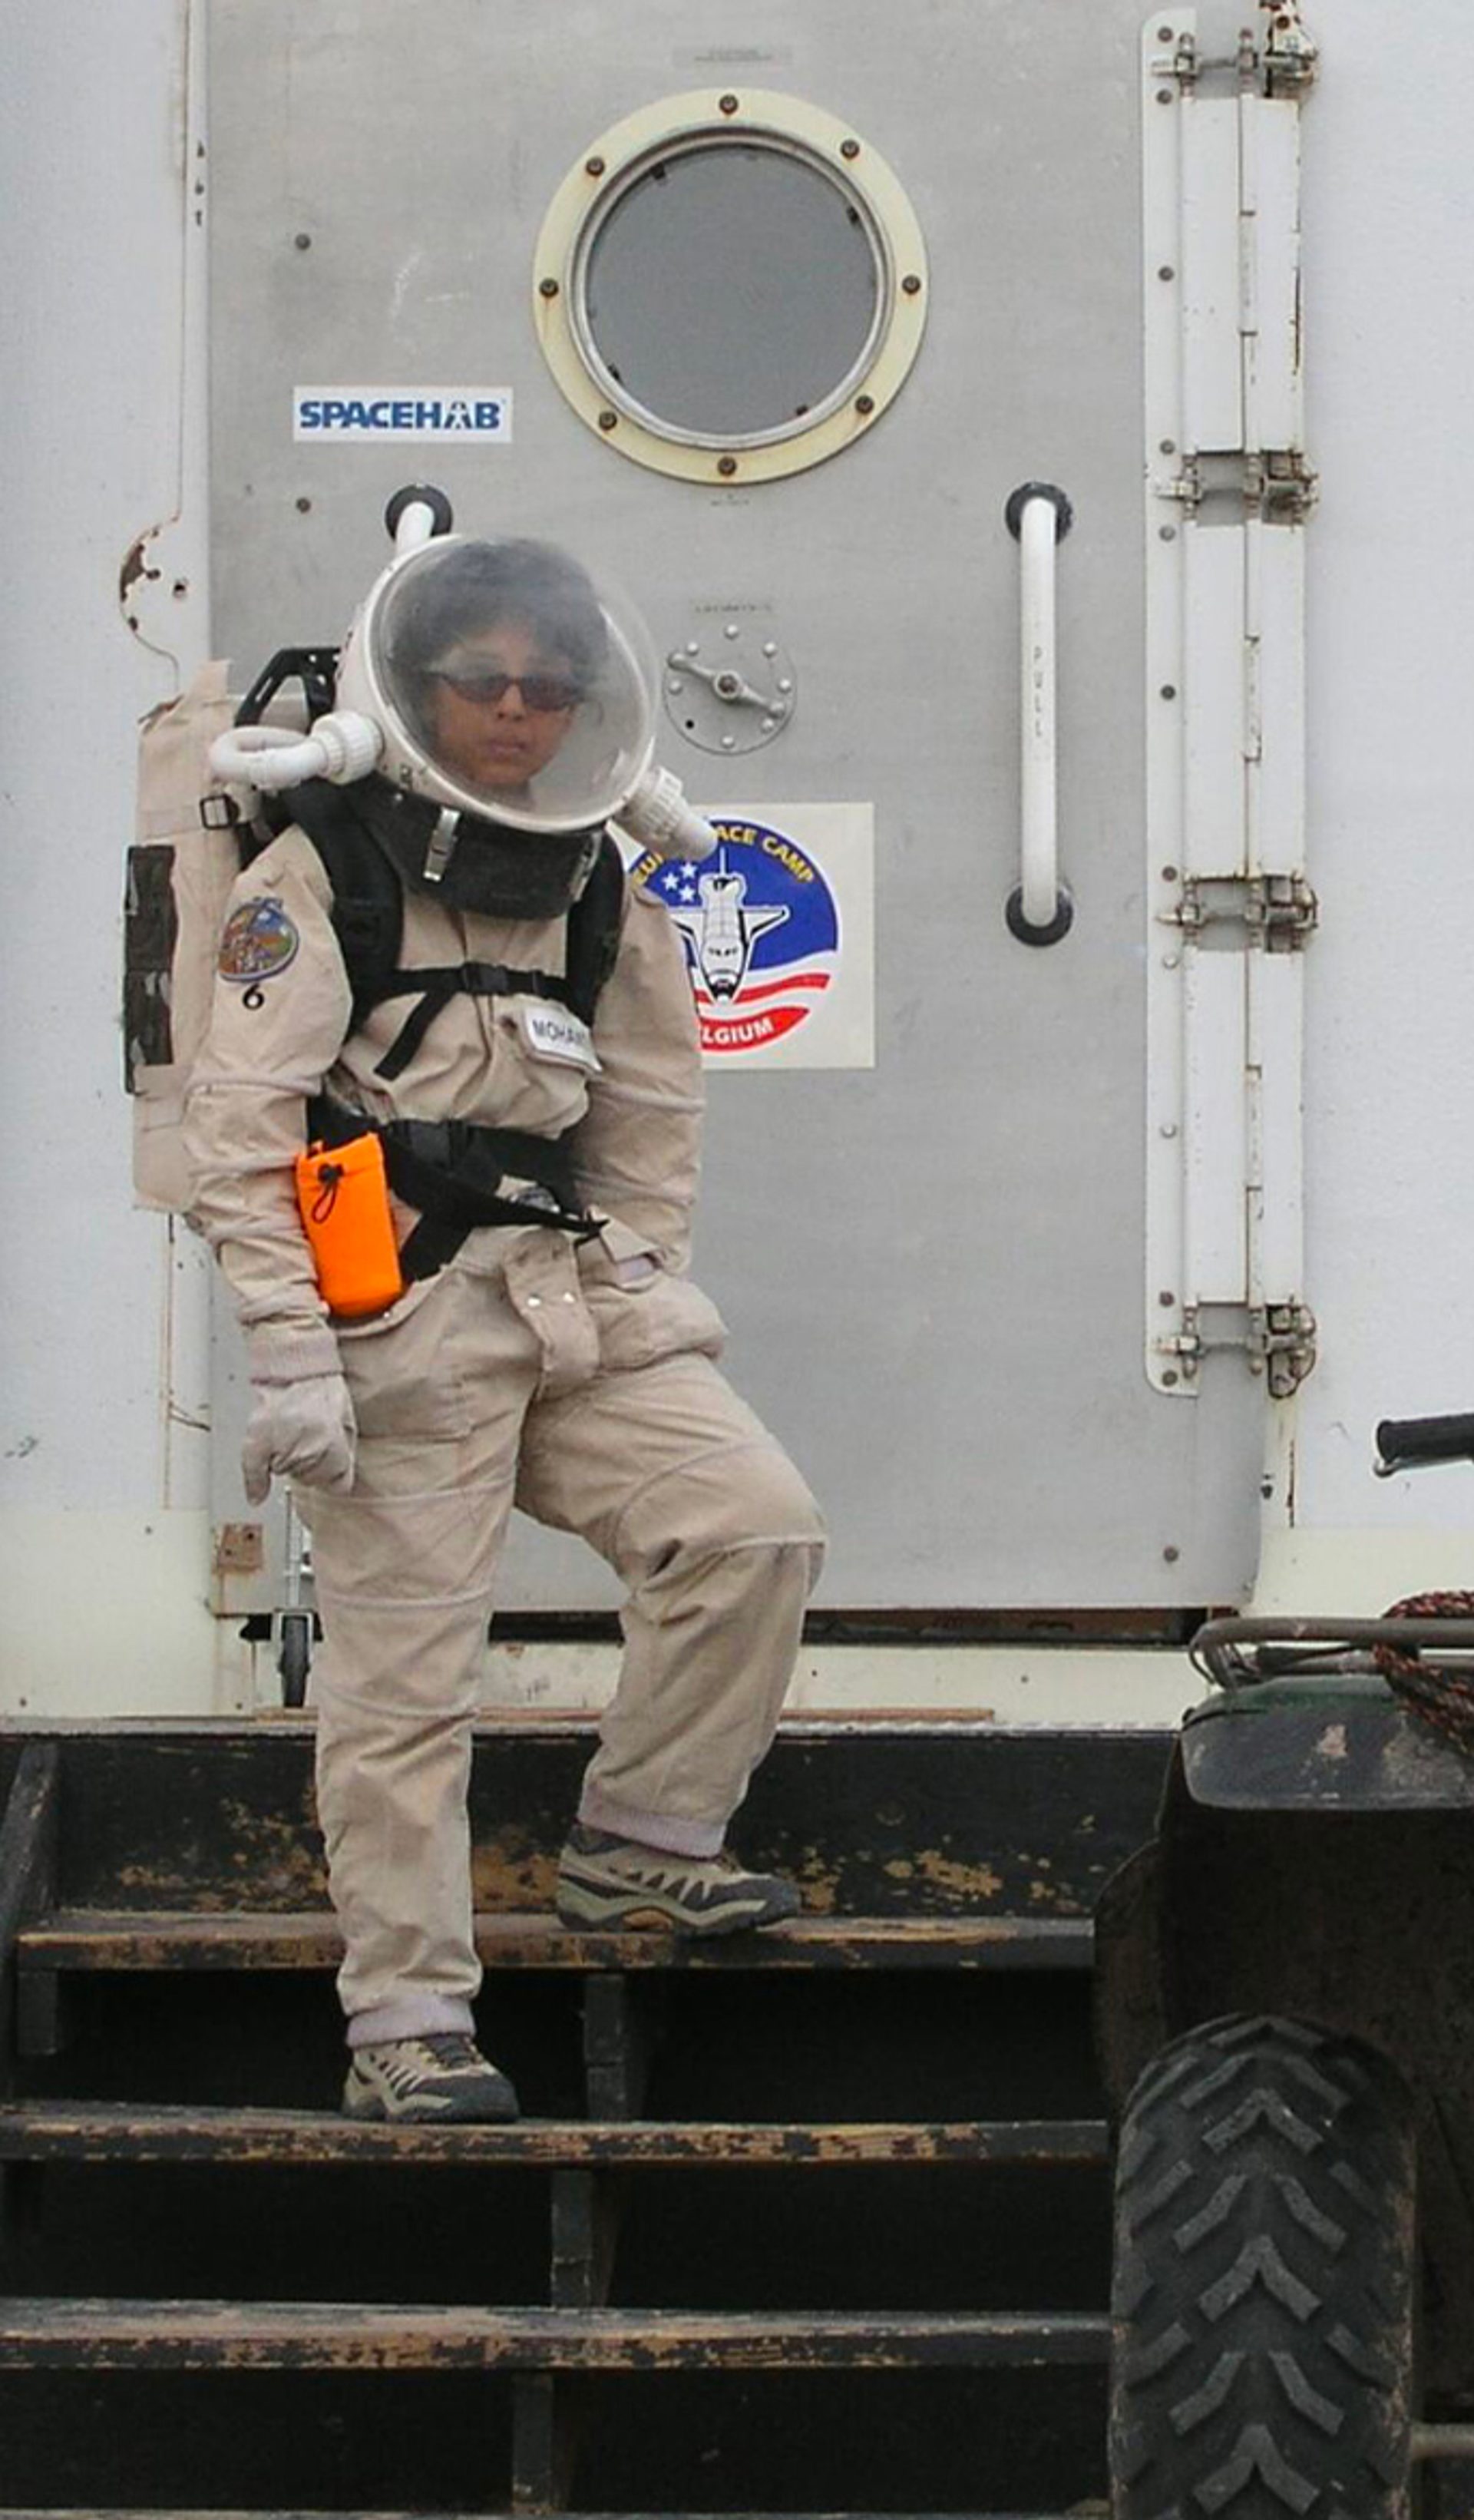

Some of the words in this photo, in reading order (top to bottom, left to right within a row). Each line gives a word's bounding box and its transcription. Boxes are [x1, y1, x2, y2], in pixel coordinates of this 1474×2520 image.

[299, 401, 501, 428] SPACEHAB
[714, 824, 758, 846] ACE
[762, 835, 814, 883] CAMP
[243, 984, 265, 1010] 6
[701, 1016, 775, 1045] LGIUM
